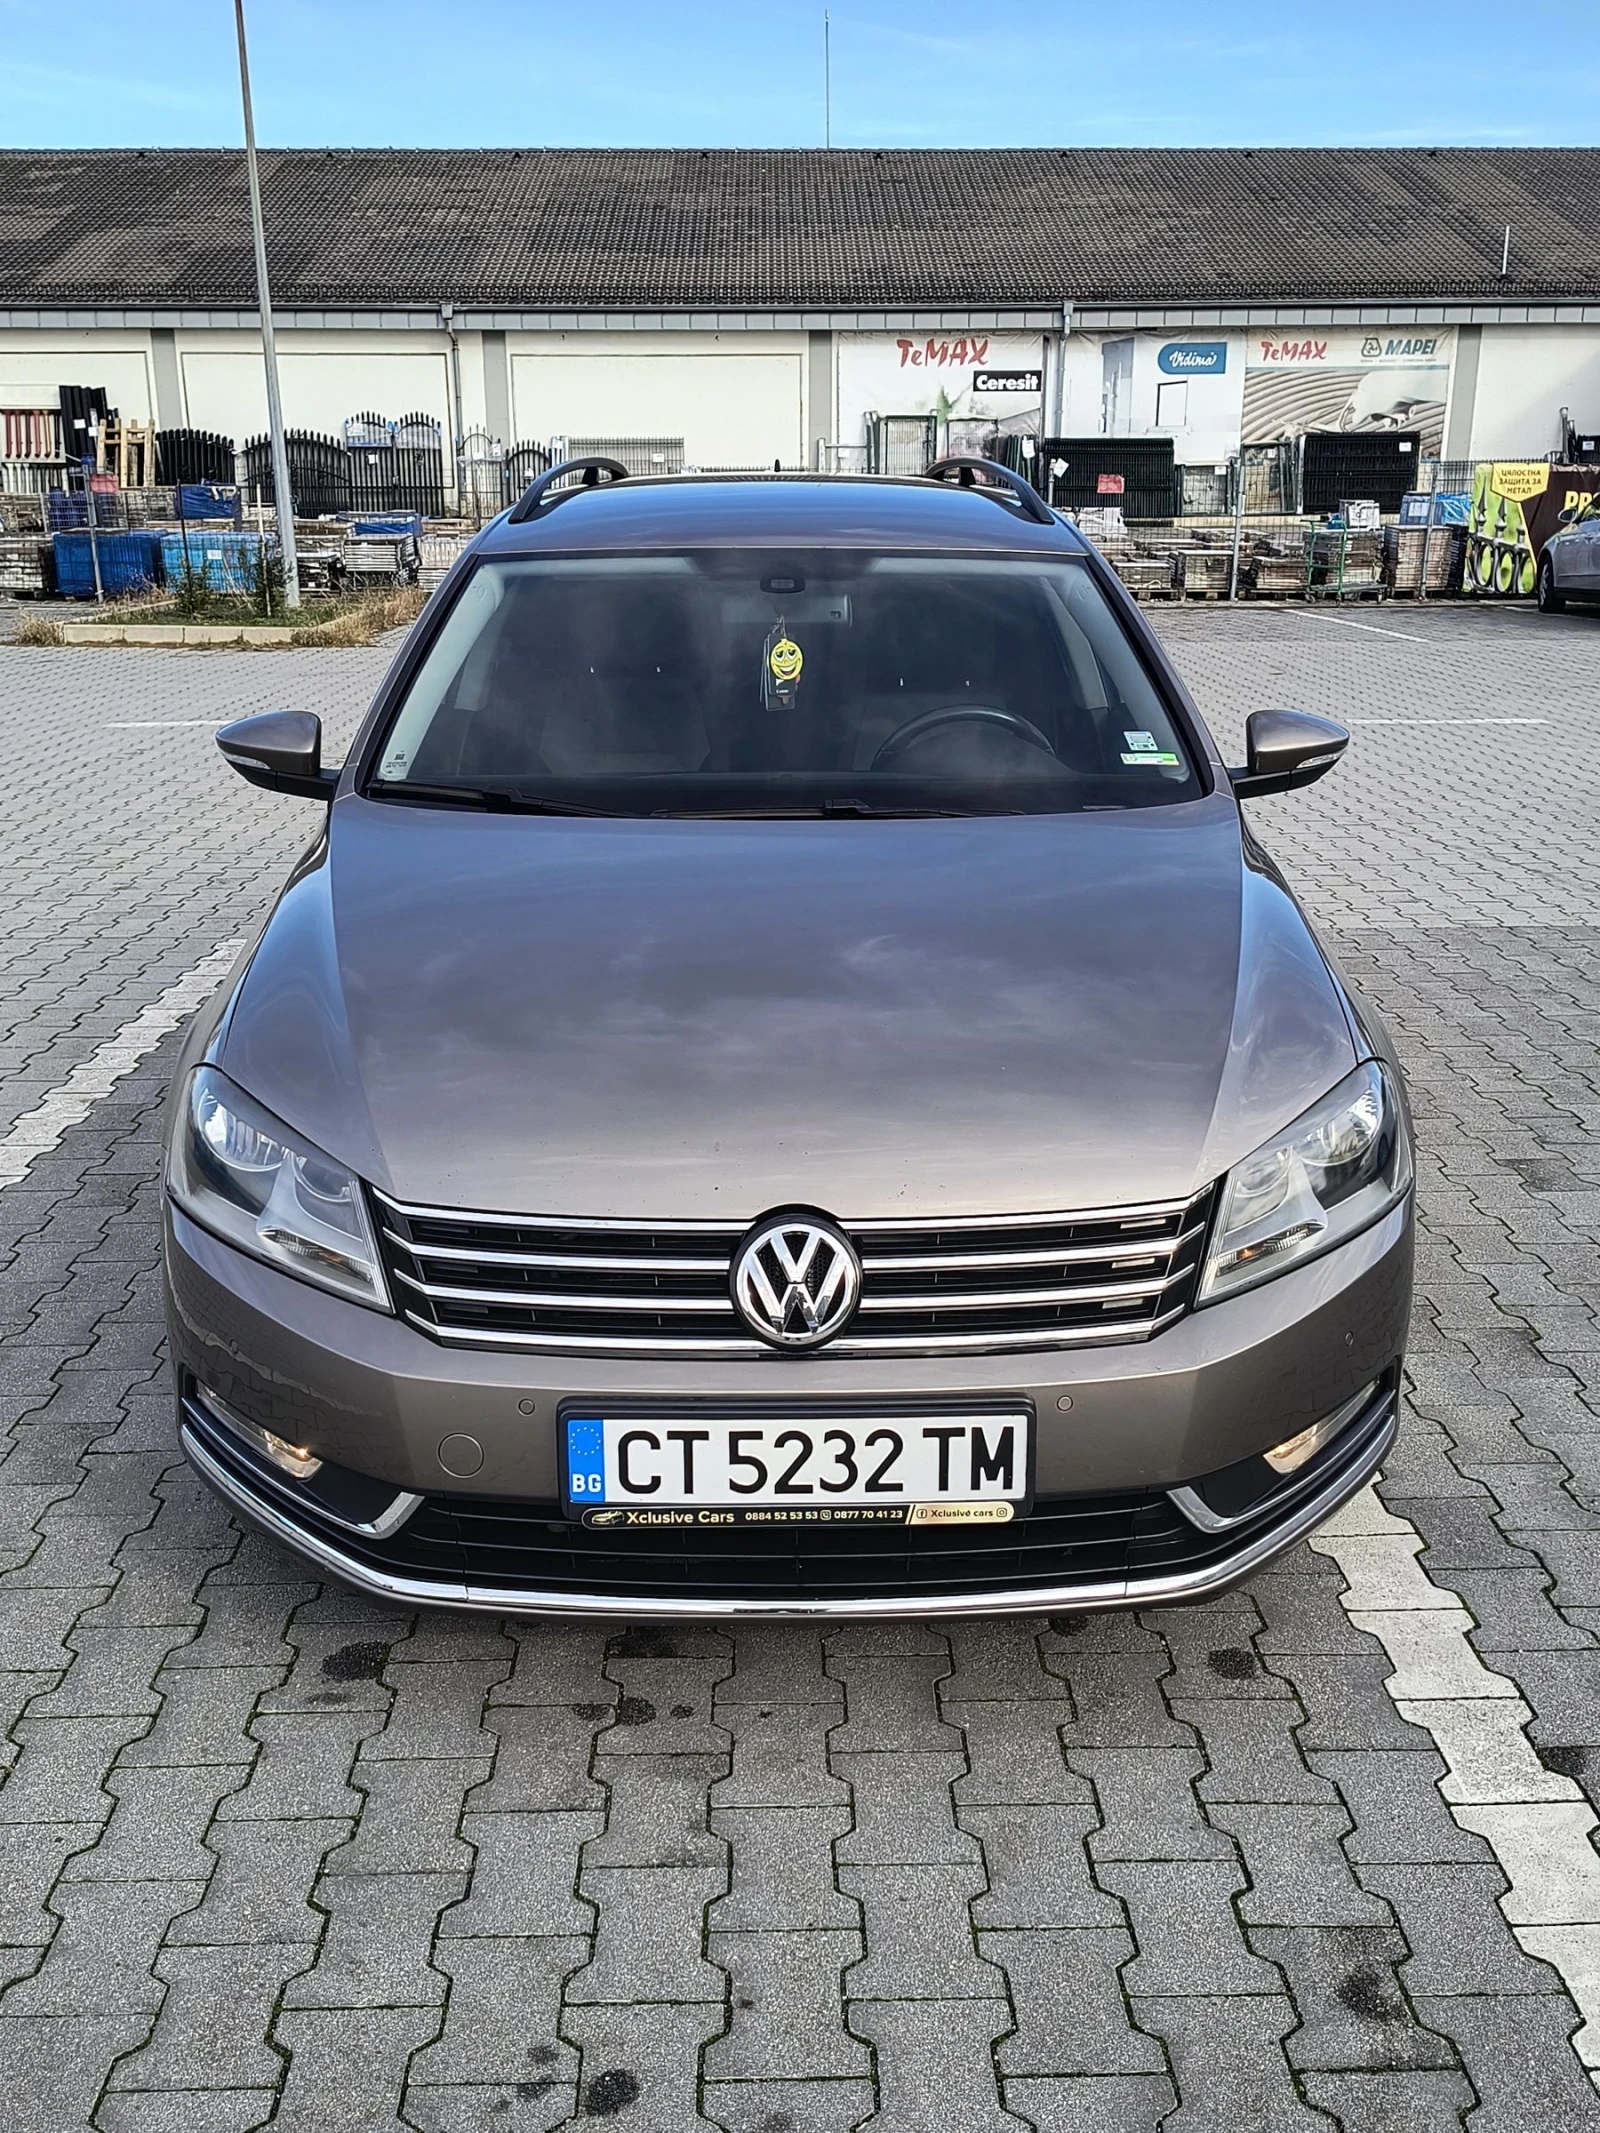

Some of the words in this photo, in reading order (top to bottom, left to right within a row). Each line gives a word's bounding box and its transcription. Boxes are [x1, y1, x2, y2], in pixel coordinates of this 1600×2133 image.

[896, 338, 989, 368] TeMAX
[1261, 339, 1328, 362] TeMAX
[1385, 338, 1438, 356] MAPEI
[1168, 350, 1217, 368] Vidima
[976, 372, 1039, 391] Ceresit
[617, 1429, 709, 1495] CT
[728, 1428, 904, 1494] 5232
[922, 1426, 1015, 1492] TM
[572, 1473, 602, 1493] BG
[626, 1511, 694, 1524] Xclusive
[698, 1510, 735, 1523] Cars
[745, 1512, 772, 1520] 0884
[774, 1512, 787, 1520] 52
[790, 1512, 803, 1520] 53
[805, 1511, 818, 1519] 53
[834, 1511, 860, 1519] 0877
[861, 1510, 874, 1518] 70
[876, 1510, 888, 1518] 41
[890, 1510, 903, 1518] 23
[973, 1509, 994, 1517] cars
